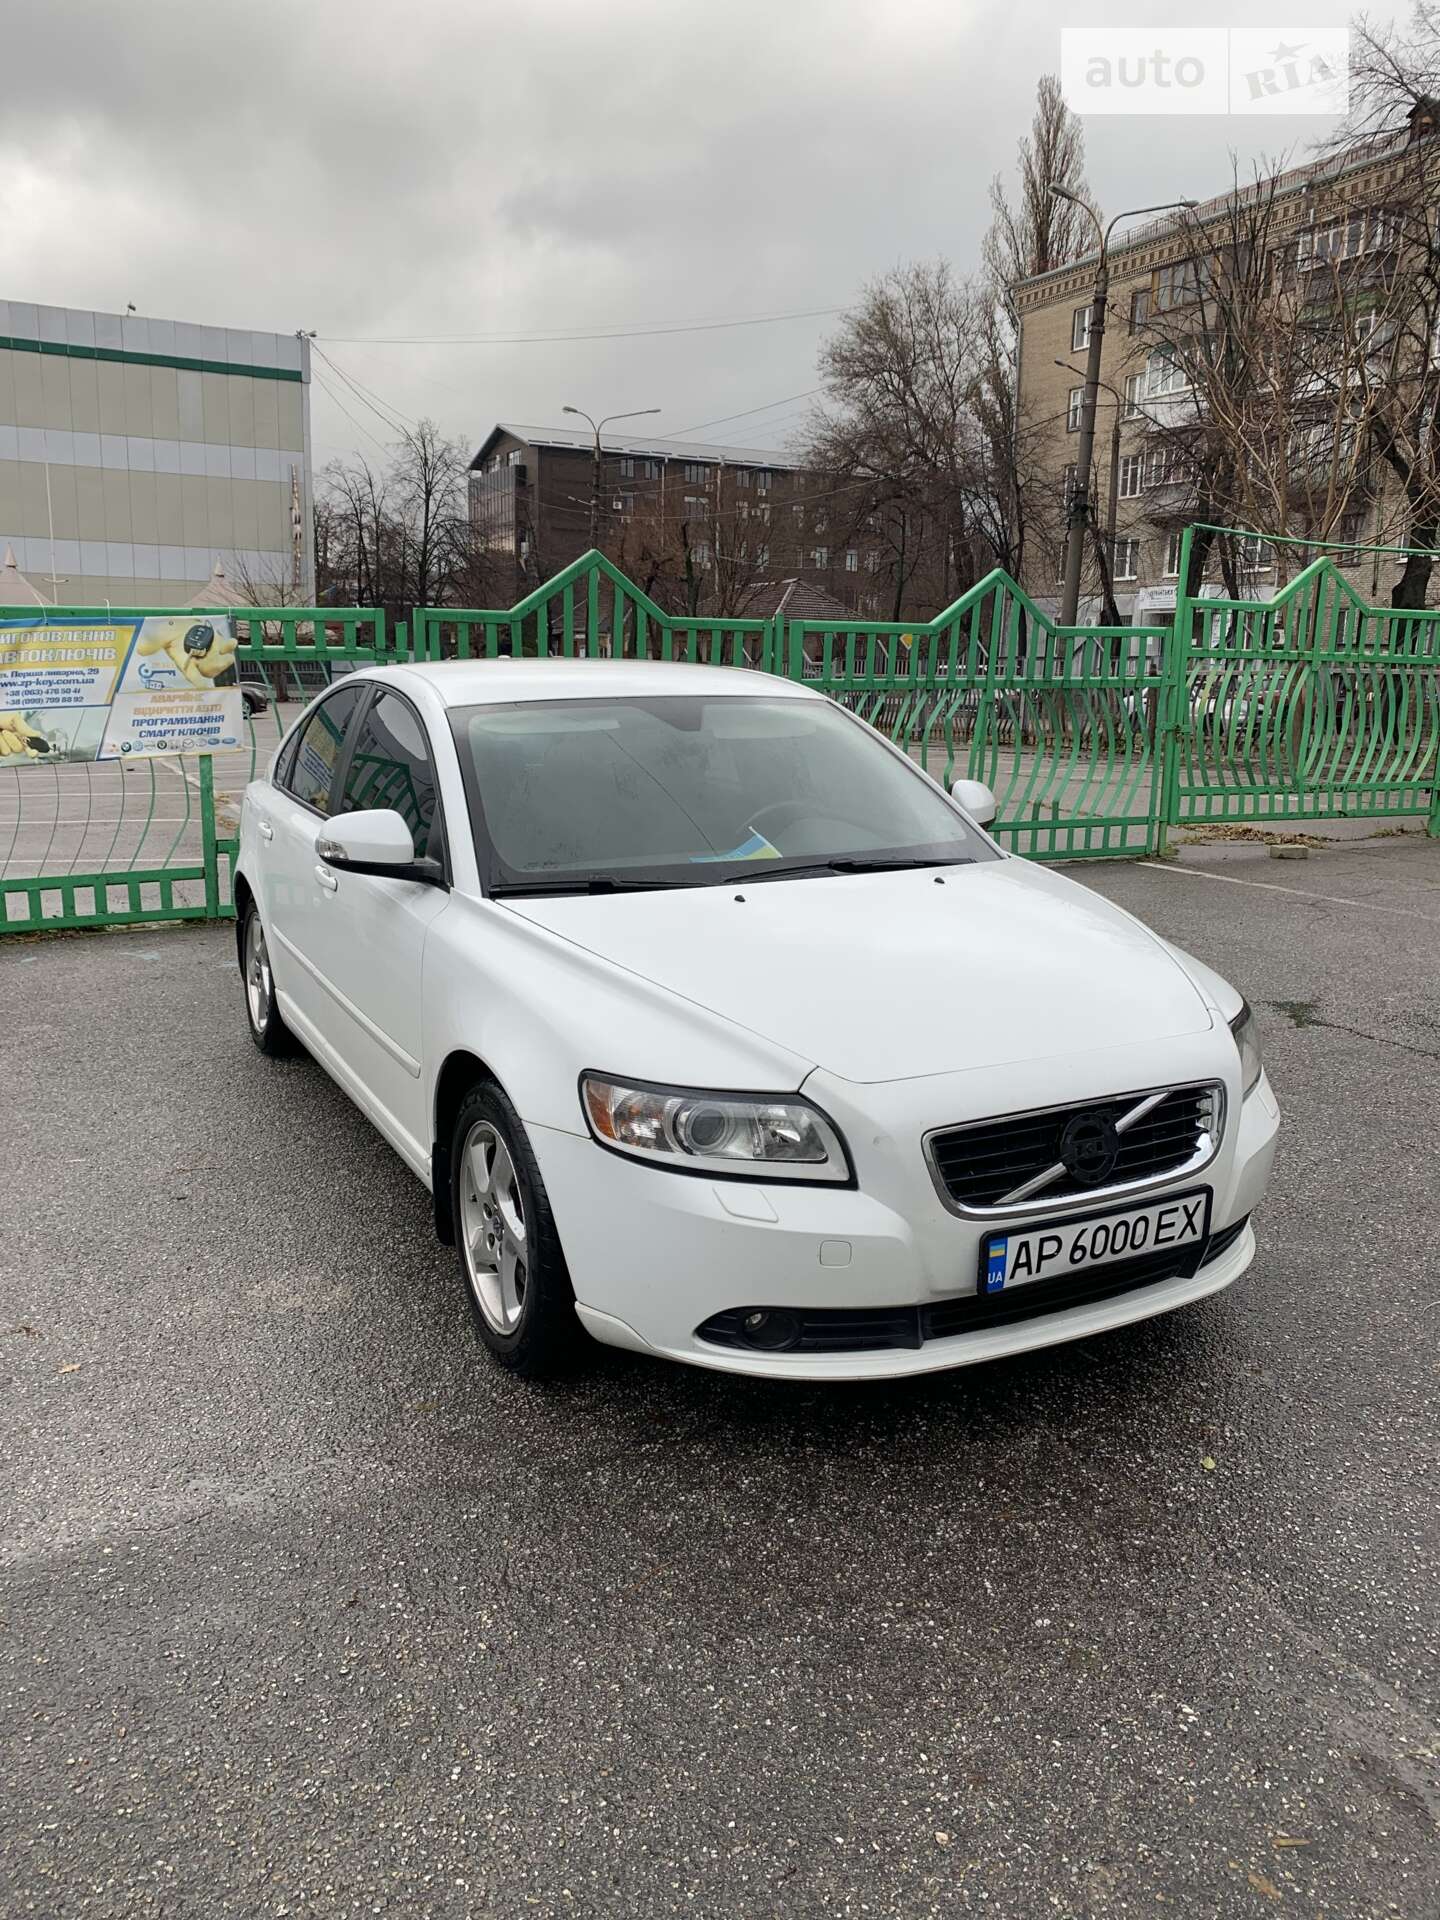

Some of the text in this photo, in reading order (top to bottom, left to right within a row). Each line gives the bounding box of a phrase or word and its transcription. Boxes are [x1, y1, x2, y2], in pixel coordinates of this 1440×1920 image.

[131, 714, 225, 728] ПРОГРАМУВАННЯ
[138, 726, 221, 739] СМАРТ КЛЮЧІВ
[1008, 1199, 1203, 1281] AP 6000 EX
[987, 1271, 1003, 1285] UA
